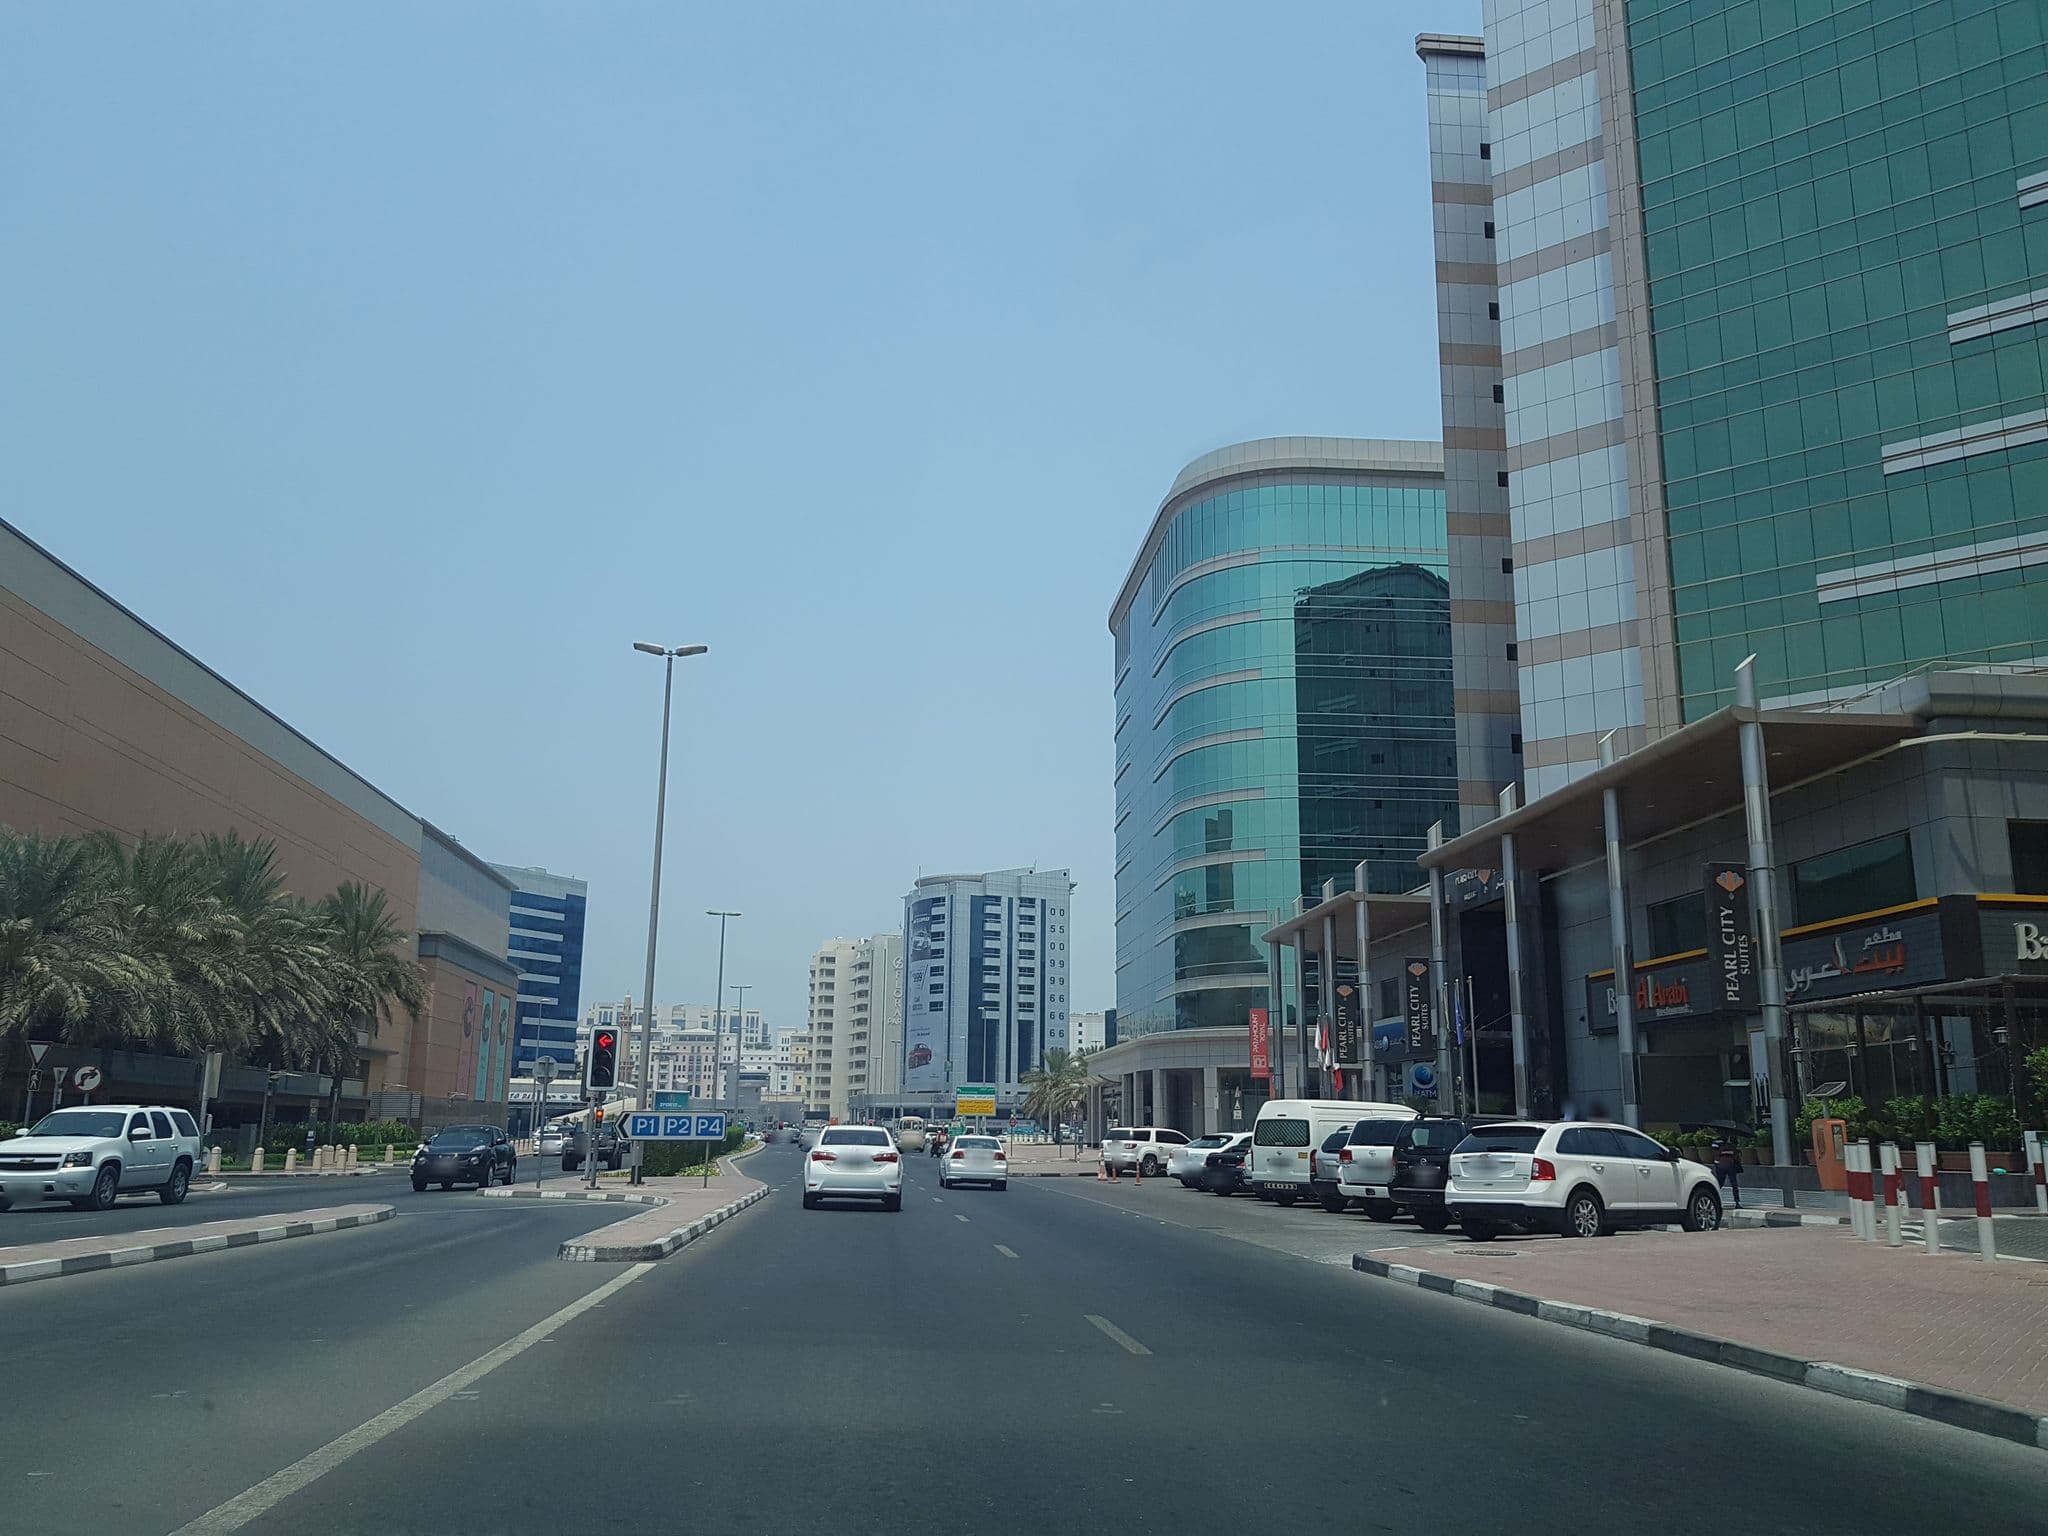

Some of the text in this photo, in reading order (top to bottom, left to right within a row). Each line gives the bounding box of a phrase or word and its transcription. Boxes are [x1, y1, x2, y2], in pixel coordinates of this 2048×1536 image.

[1720, 906, 1740, 1001] PEARL CITY
[1737, 935, 1751, 975] SUITES
[1338, 1004, 1348, 1059] PEARL CITY
[1409, 985, 1421, 1047] PEARL CITY
[1421, 1003, 1429, 1030] SUITES
[637, 1118, 721, 1134] P1 P2 P4
